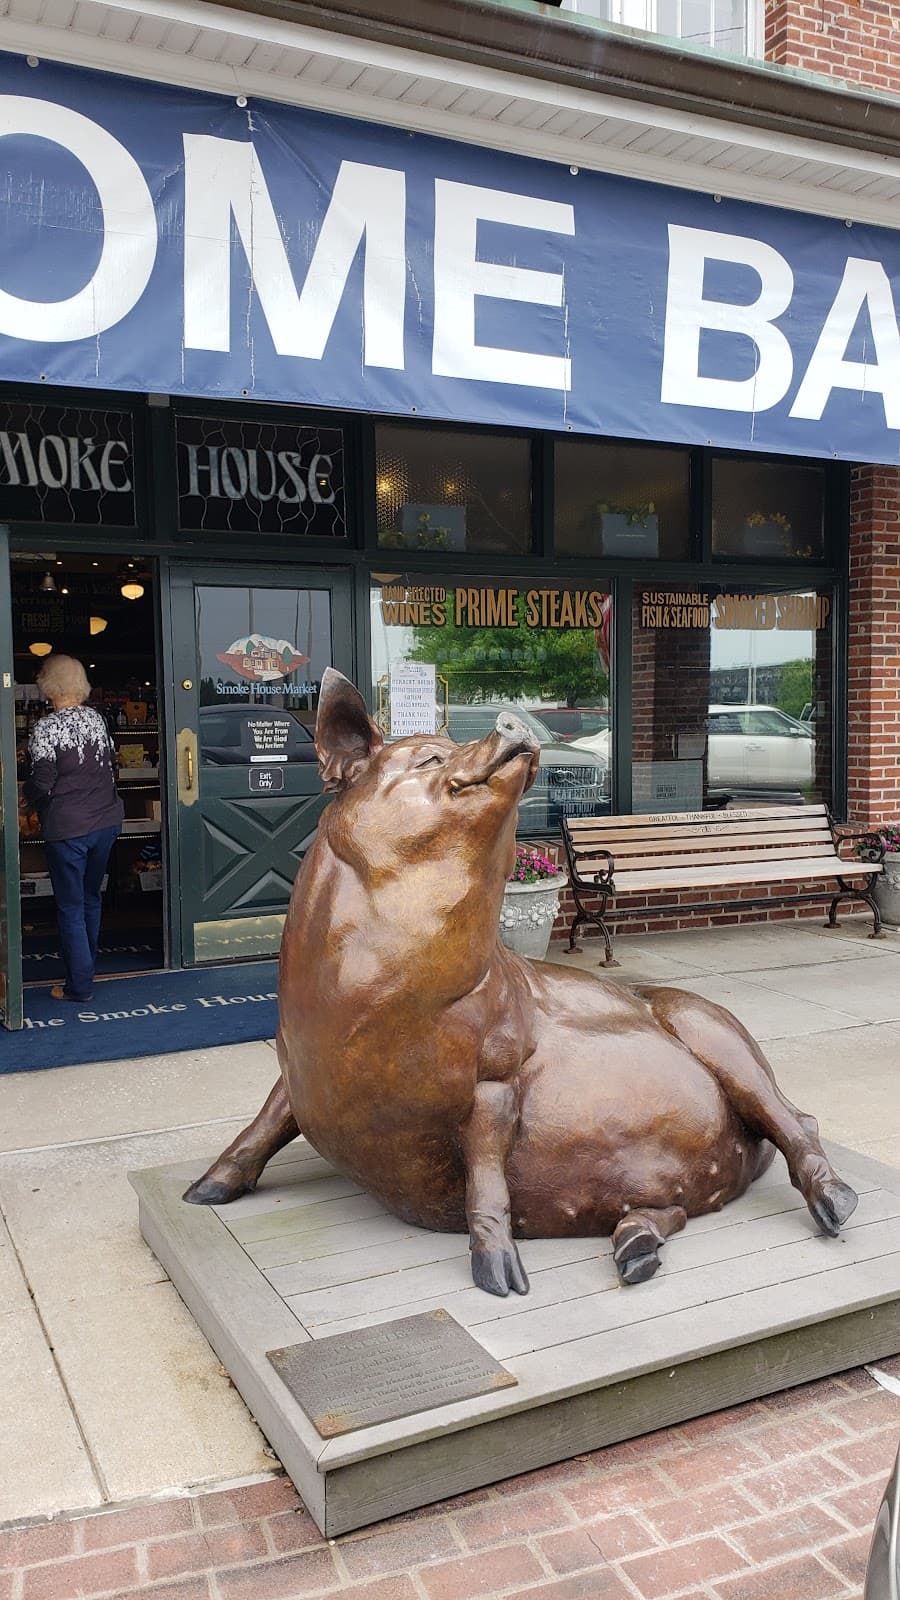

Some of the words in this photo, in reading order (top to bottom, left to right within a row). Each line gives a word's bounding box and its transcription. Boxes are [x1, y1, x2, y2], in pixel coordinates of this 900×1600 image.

[182, 443, 336, 503] HOUSE
[407, 586, 446, 602] SELECTED
[642, 592, 709, 605] SUSTAINABLE
[382, 602, 446, 625] WINES
[455, 588, 518, 627] PRIME
[526, 590, 603, 628] STEAKS
[216, 683, 249, 695] Smoke
[250, 683, 281, 695] House
[282, 682, 317, 695] Market
[259, 772, 272, 780] Exit
[259, 780, 272, 788] Only
[24, 1016, 65, 1029] he
[77, 1002, 189, 1024] Smoke
[196, 991, 280, 1009] Hous
